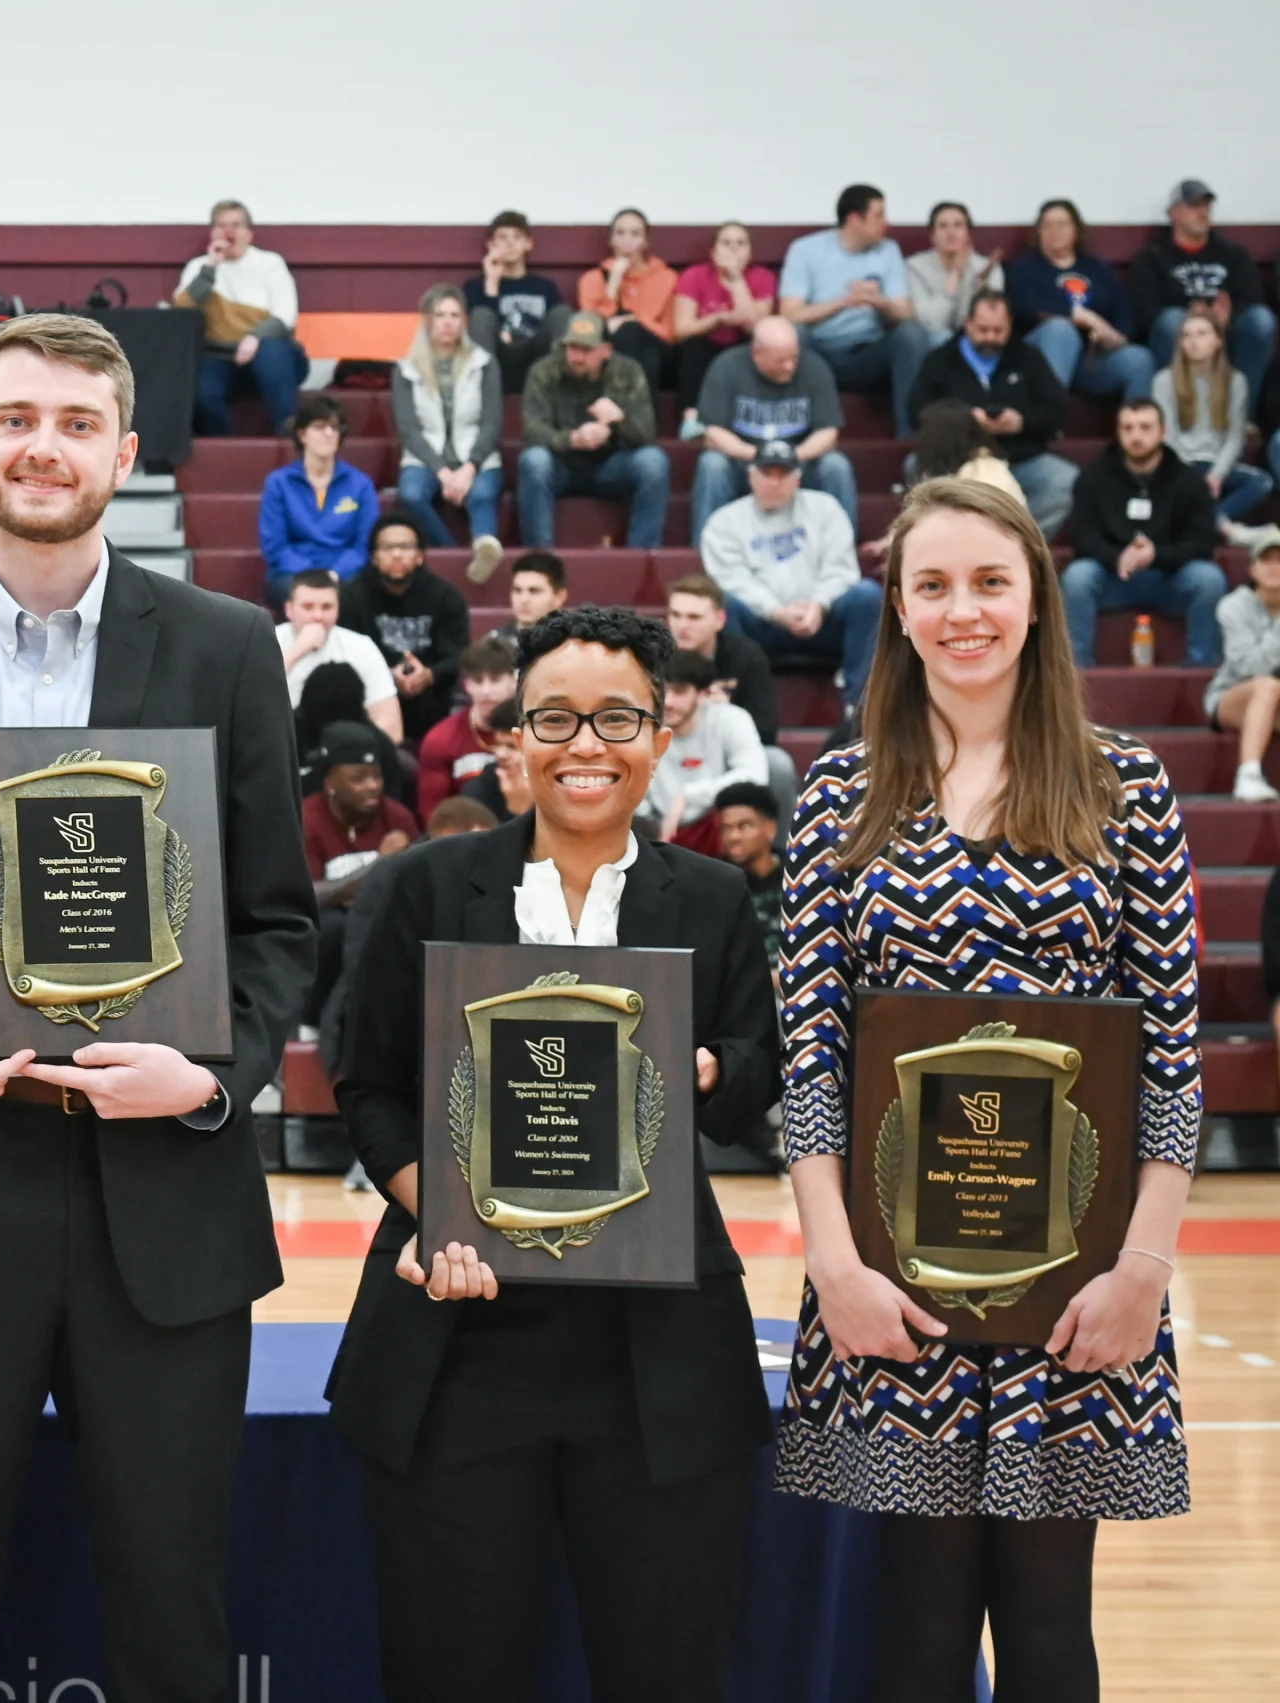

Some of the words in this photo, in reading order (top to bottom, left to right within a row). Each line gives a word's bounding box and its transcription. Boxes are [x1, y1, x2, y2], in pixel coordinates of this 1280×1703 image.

[39, 857, 87, 866] Susquehanna
[89, 856, 127, 864] University
[47, 866, 70, 875] Sports
[44, 891, 68, 900] Kade
[71, 891, 126, 901] MacGregor
[508, 1080, 556, 1089] Susquehanna
[558, 1082, 596, 1092] University
[516, 1090, 539, 1099] Sports
[526, 1115, 548, 1124] Toni
[551, 1116, 578, 1125] Davis
[938, 1136, 987, 1147] Susquehanna
[990, 1138, 1029, 1149] University
[551, 1151, 590, 1162] Swimming
[945, 1147, 969, 1156] Sports
[1000, 1150, 1022, 1158] Fame
[928, 1170, 955, 1184] Emily
[958, 1173, 1037, 1188] Carson-Wagner
[988, 1194, 1008, 1202] 2013
[962, 1210, 1000, 1219] Volleyball
